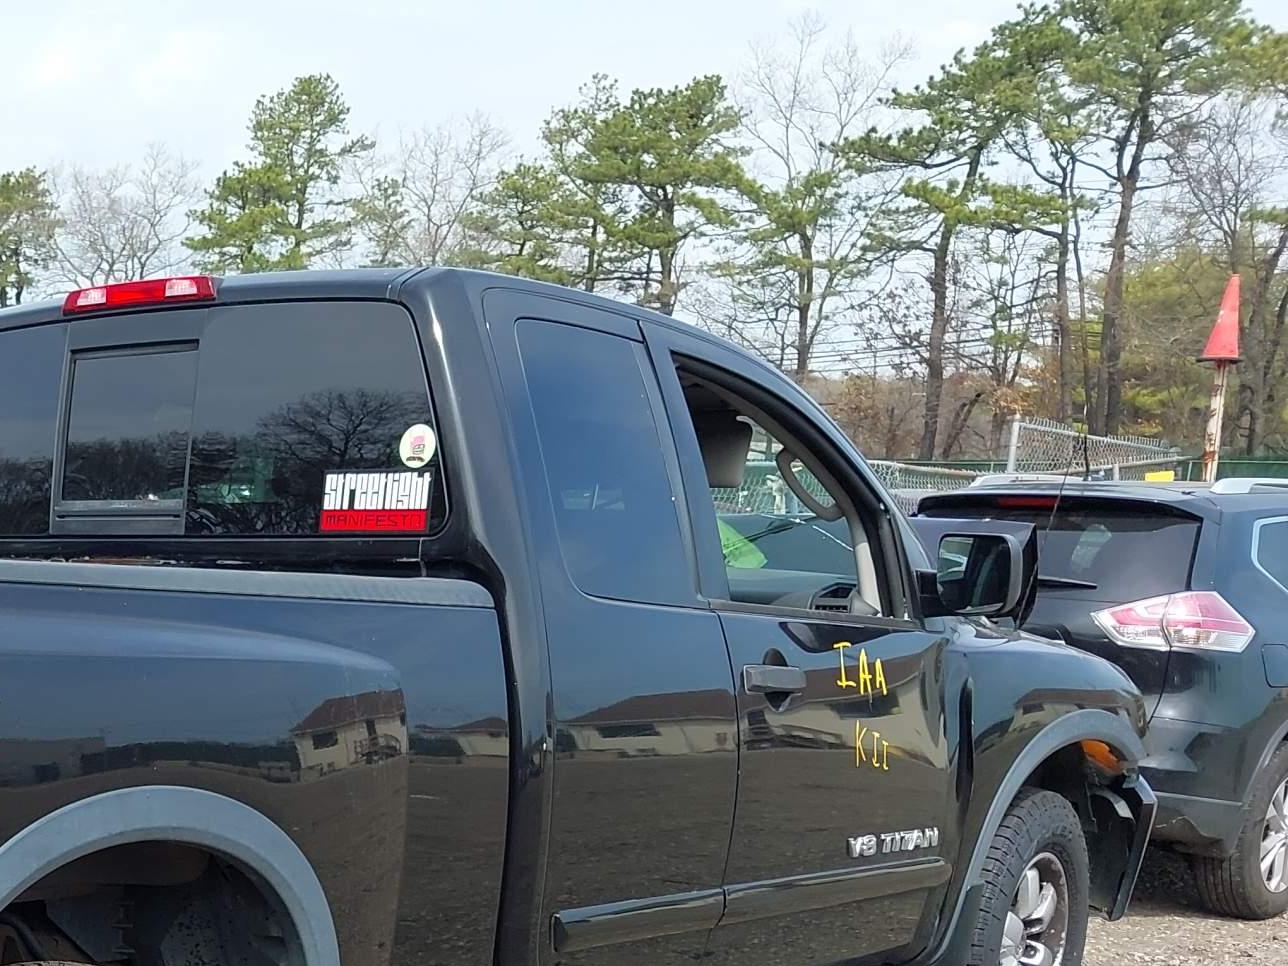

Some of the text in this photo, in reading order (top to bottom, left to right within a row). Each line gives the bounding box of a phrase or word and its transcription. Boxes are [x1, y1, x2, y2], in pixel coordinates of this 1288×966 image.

[323, 472, 431, 510] streetlight
[326, 513, 422, 528] MANIFESTO
[833, 641, 888, 698] IAA
[848, 827, 939, 858] V8 TITAN
